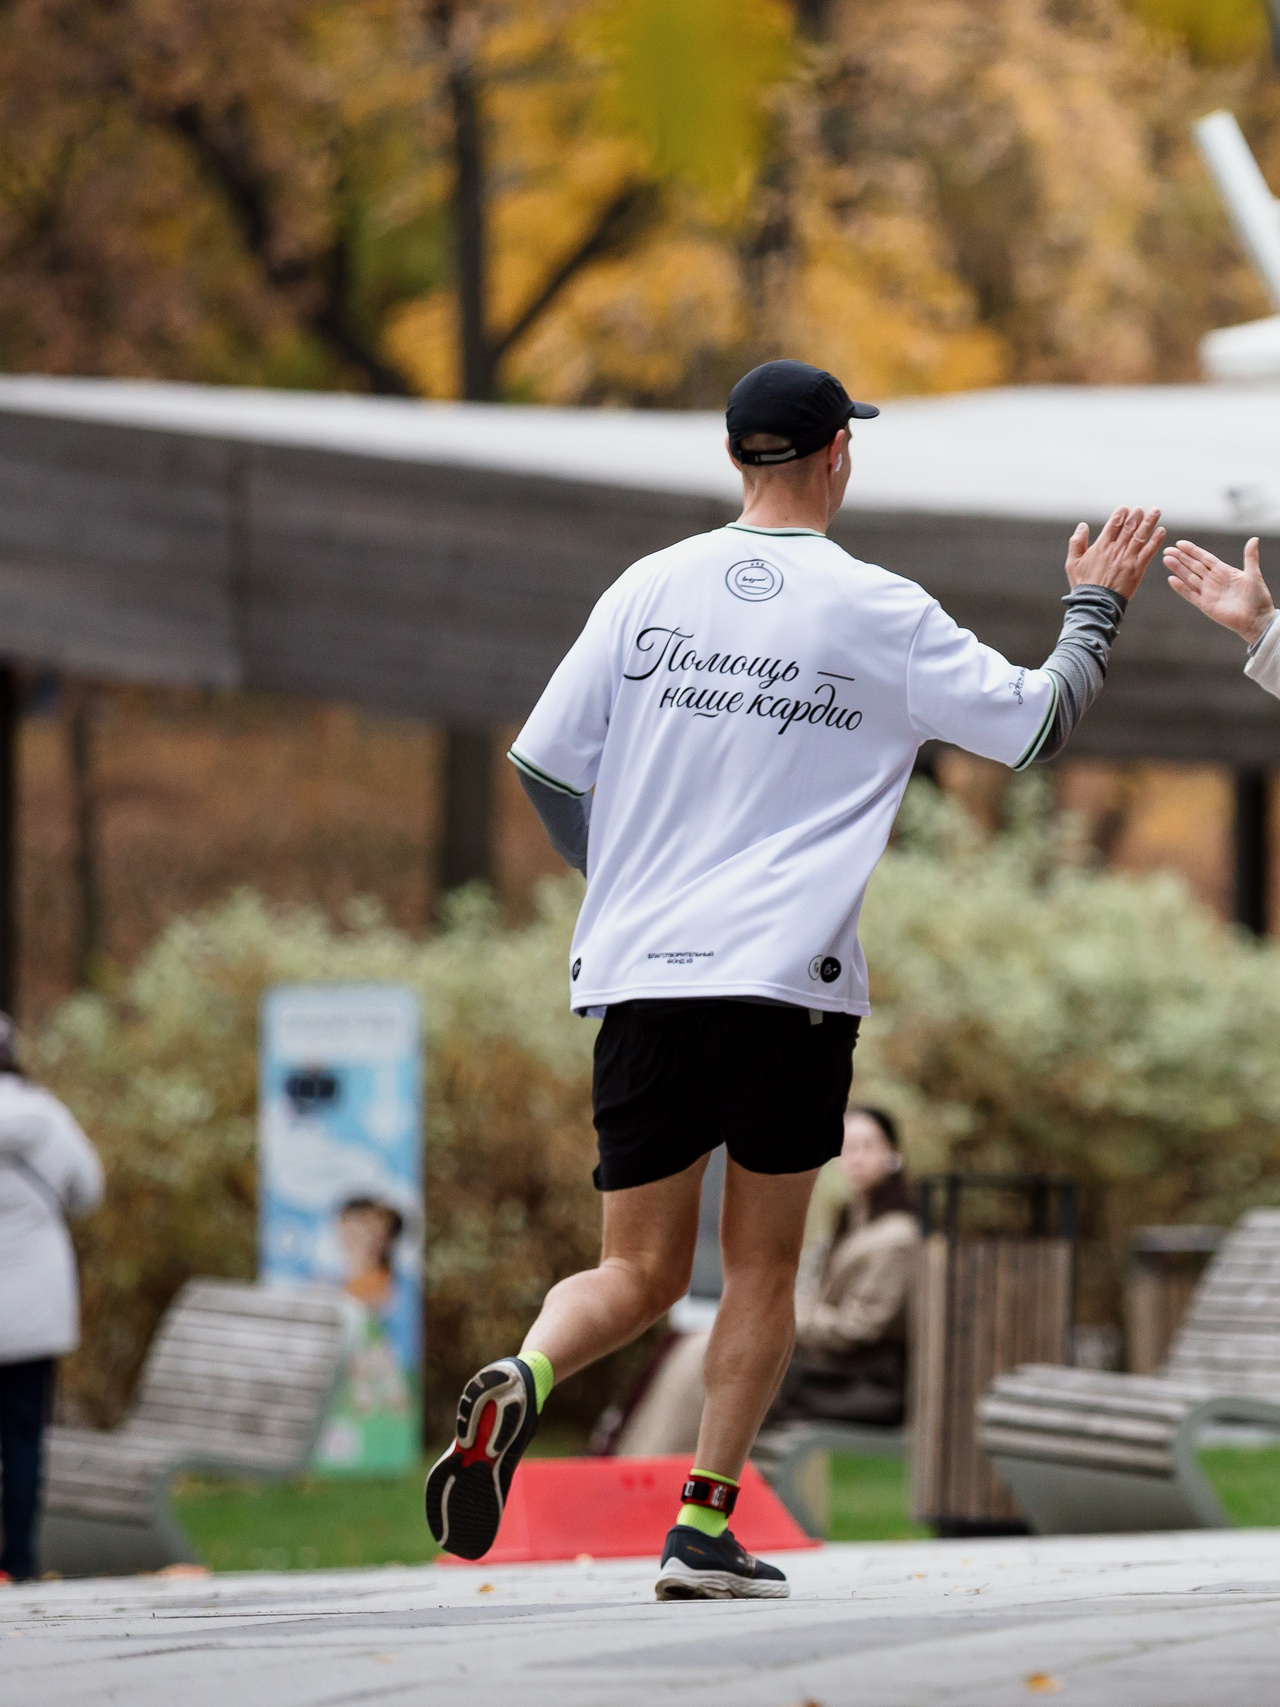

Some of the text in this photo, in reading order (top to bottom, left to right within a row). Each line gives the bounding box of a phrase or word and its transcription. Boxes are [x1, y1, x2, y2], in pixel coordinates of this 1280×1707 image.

[623, 626, 800, 690] Помощь
[660, 683, 863, 735] наше кардио
